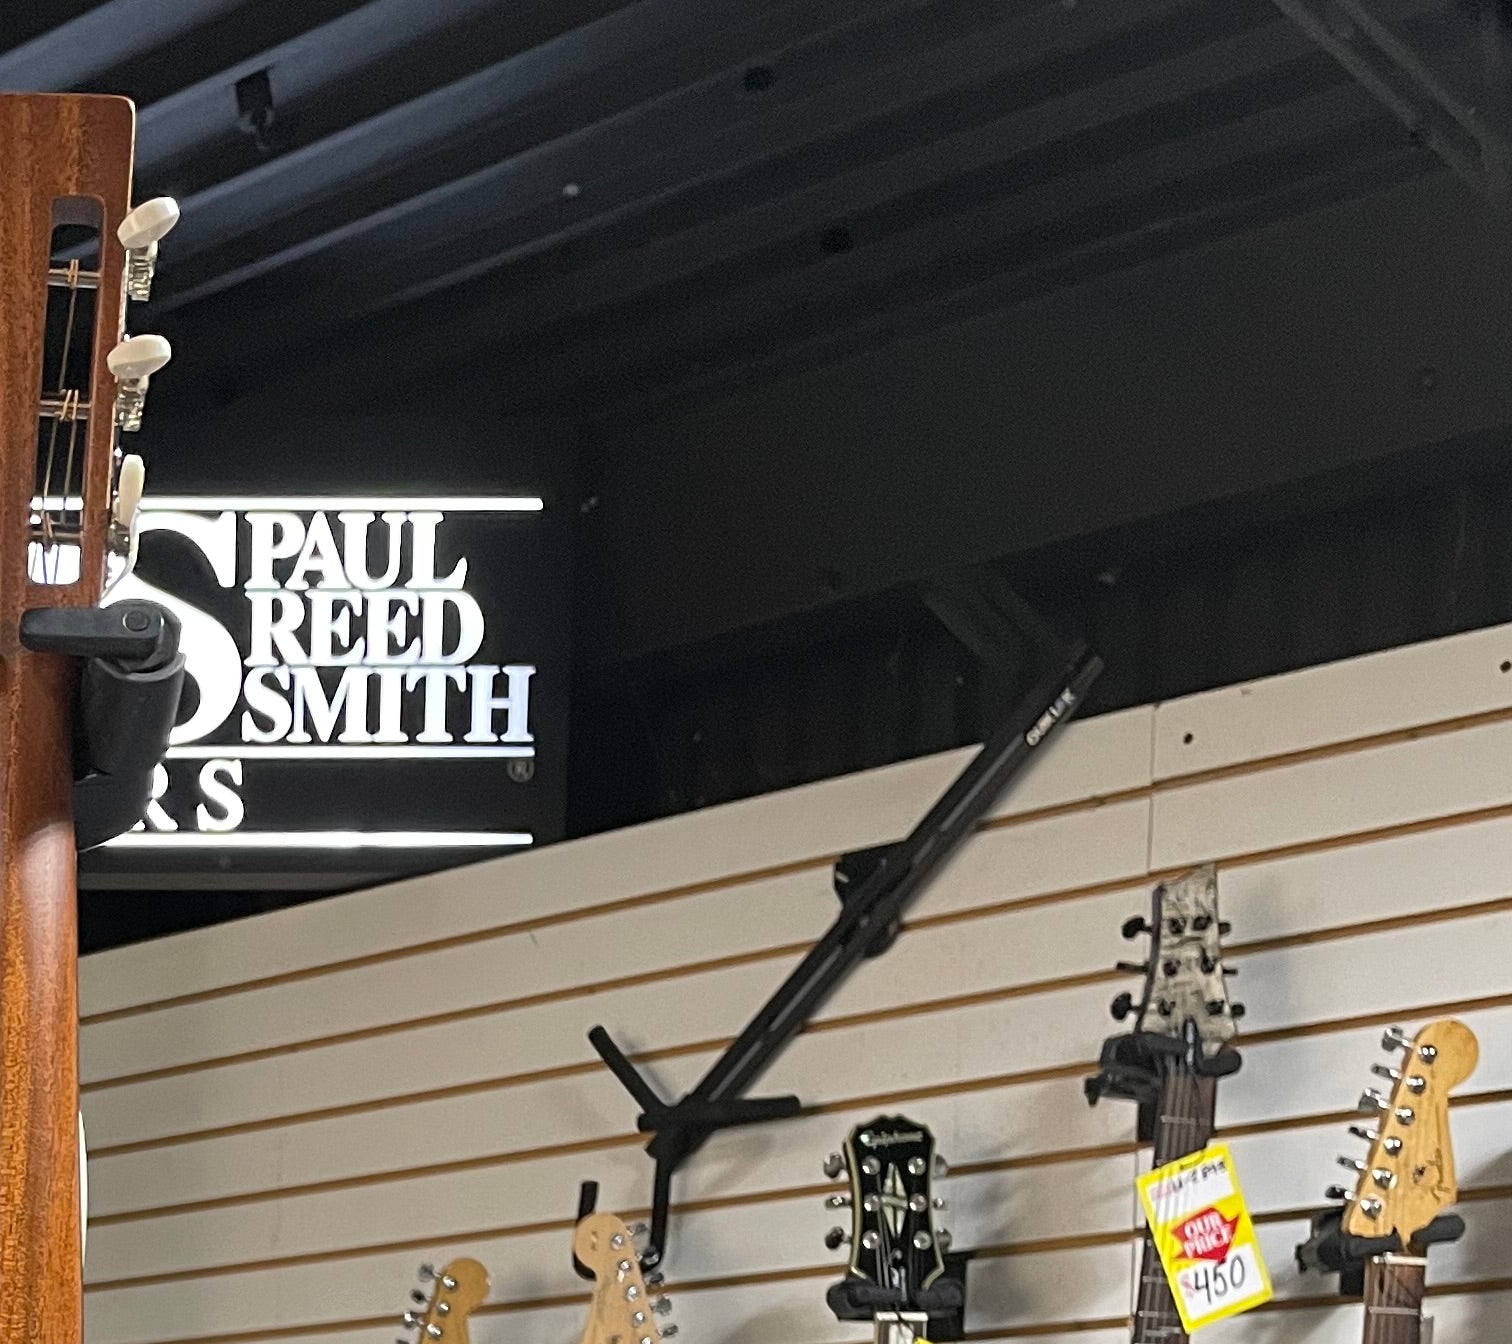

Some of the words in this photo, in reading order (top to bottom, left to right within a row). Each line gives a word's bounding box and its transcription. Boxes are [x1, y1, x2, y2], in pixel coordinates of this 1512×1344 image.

[245, 511, 469, 590] PAUL
[245, 588, 487, 667] REED
[241, 665, 538, 744] SMITH
[1183, 1211, 1224, 1238] OUR
[1183, 1224, 1234, 1258] PRICE
